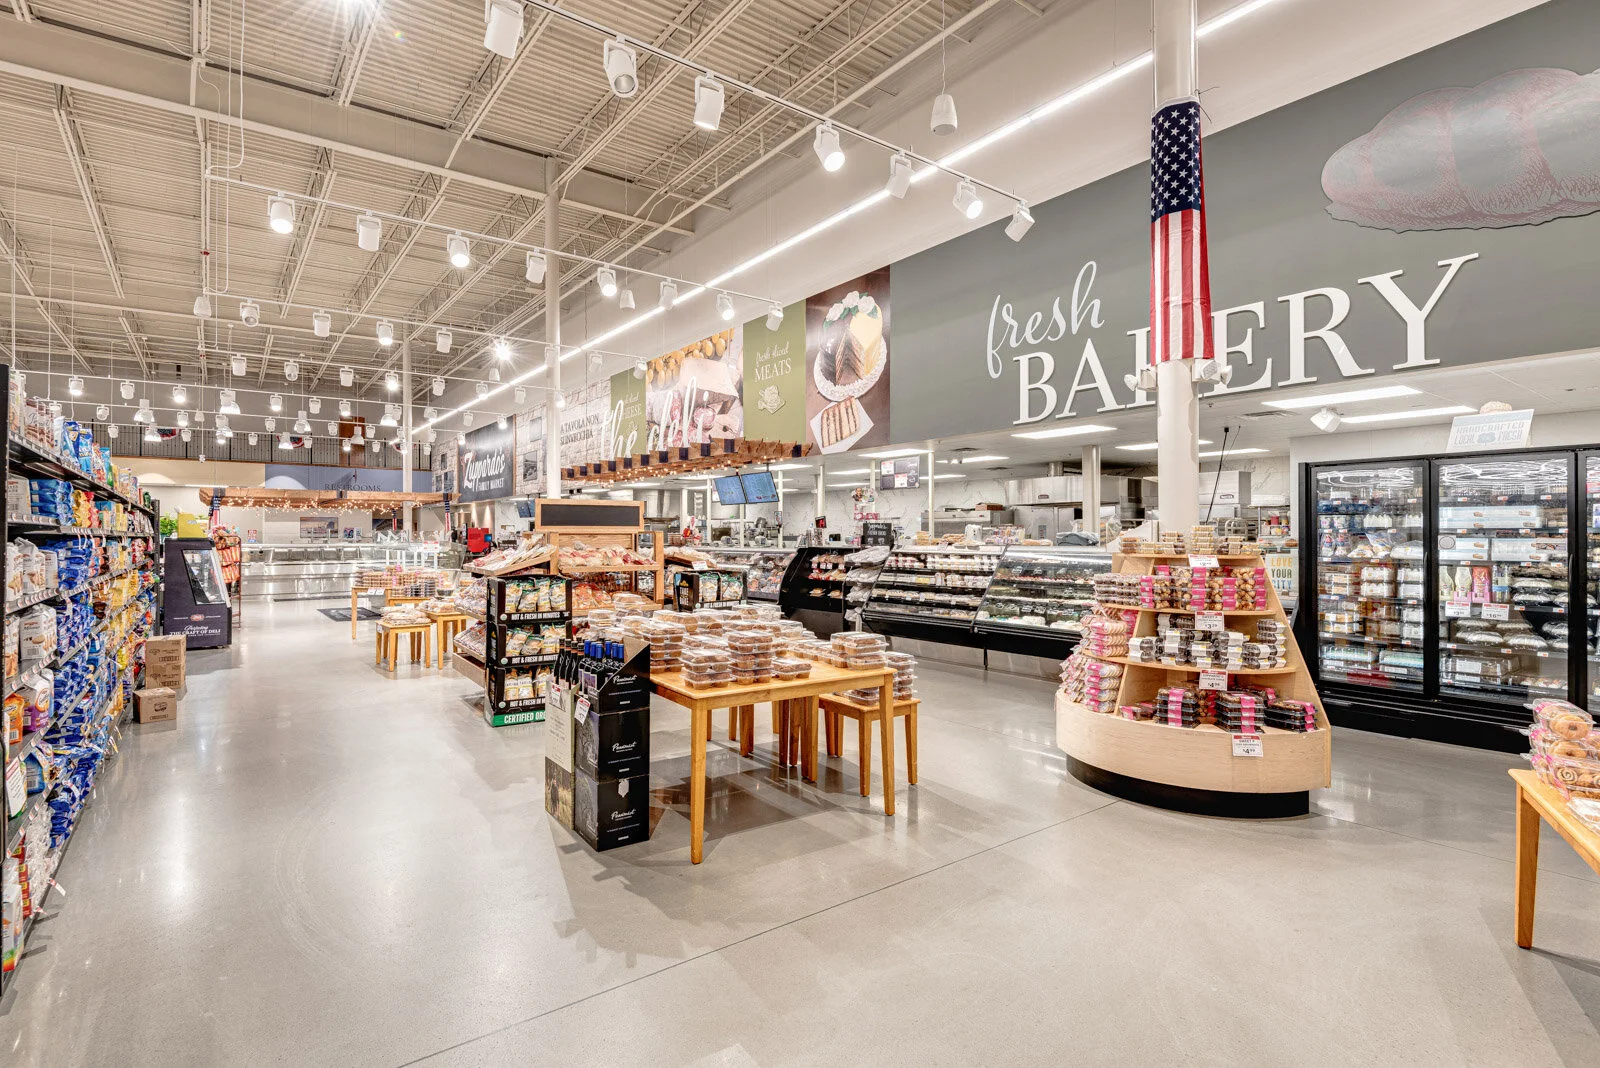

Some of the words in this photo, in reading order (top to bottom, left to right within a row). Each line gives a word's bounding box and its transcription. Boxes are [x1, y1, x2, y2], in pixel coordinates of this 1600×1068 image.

[986, 260, 1105, 379] fresh
[755, 357, 792, 382] MEATS
[463, 446, 506, 492] Zuppardo's
[324, 483, 381, 492] RESTROOMS
[490, 478, 504, 490] MARKET
[1271, 557, 1293, 567] LOVE
[1271, 568, 1293, 579] YOUR
[511, 613, 520, 621] HOT
[524, 612, 537, 620] FRESH
[543, 611, 560, 619] MINUTES
[511, 656, 520, 664] HOT
[525, 655, 537, 663] FRESH
[509, 699, 519, 708] HOT
[523, 698, 536, 706] FRESH
[504, 713, 534, 724] CERTIFIED
